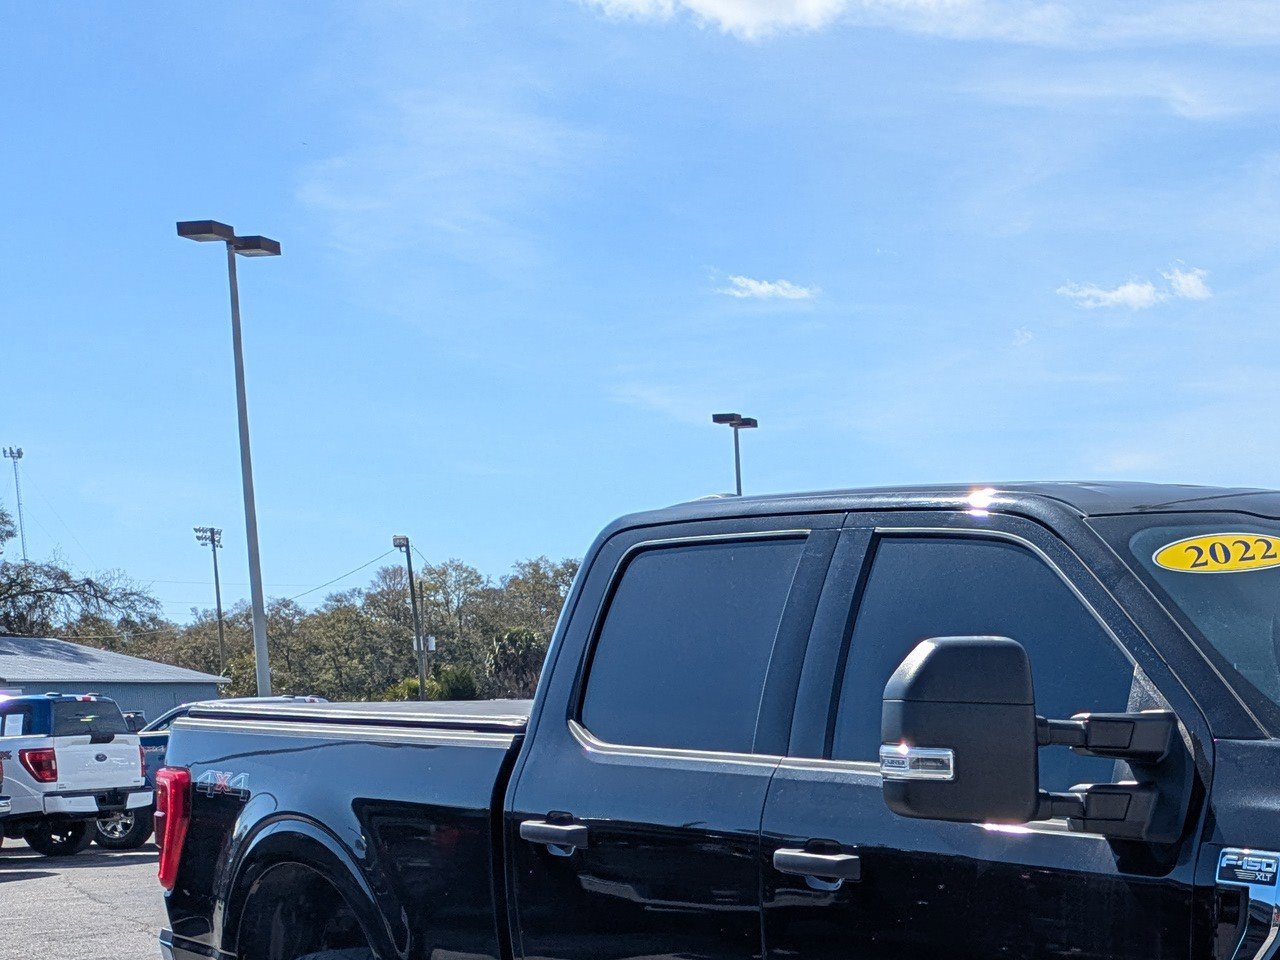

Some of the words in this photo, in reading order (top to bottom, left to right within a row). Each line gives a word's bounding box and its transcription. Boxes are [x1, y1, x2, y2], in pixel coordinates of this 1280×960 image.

[1184, 538, 1278, 568] 2022
[1221, 854, 1278, 873] F-150
[1255, 872, 1274, 882] XLT
